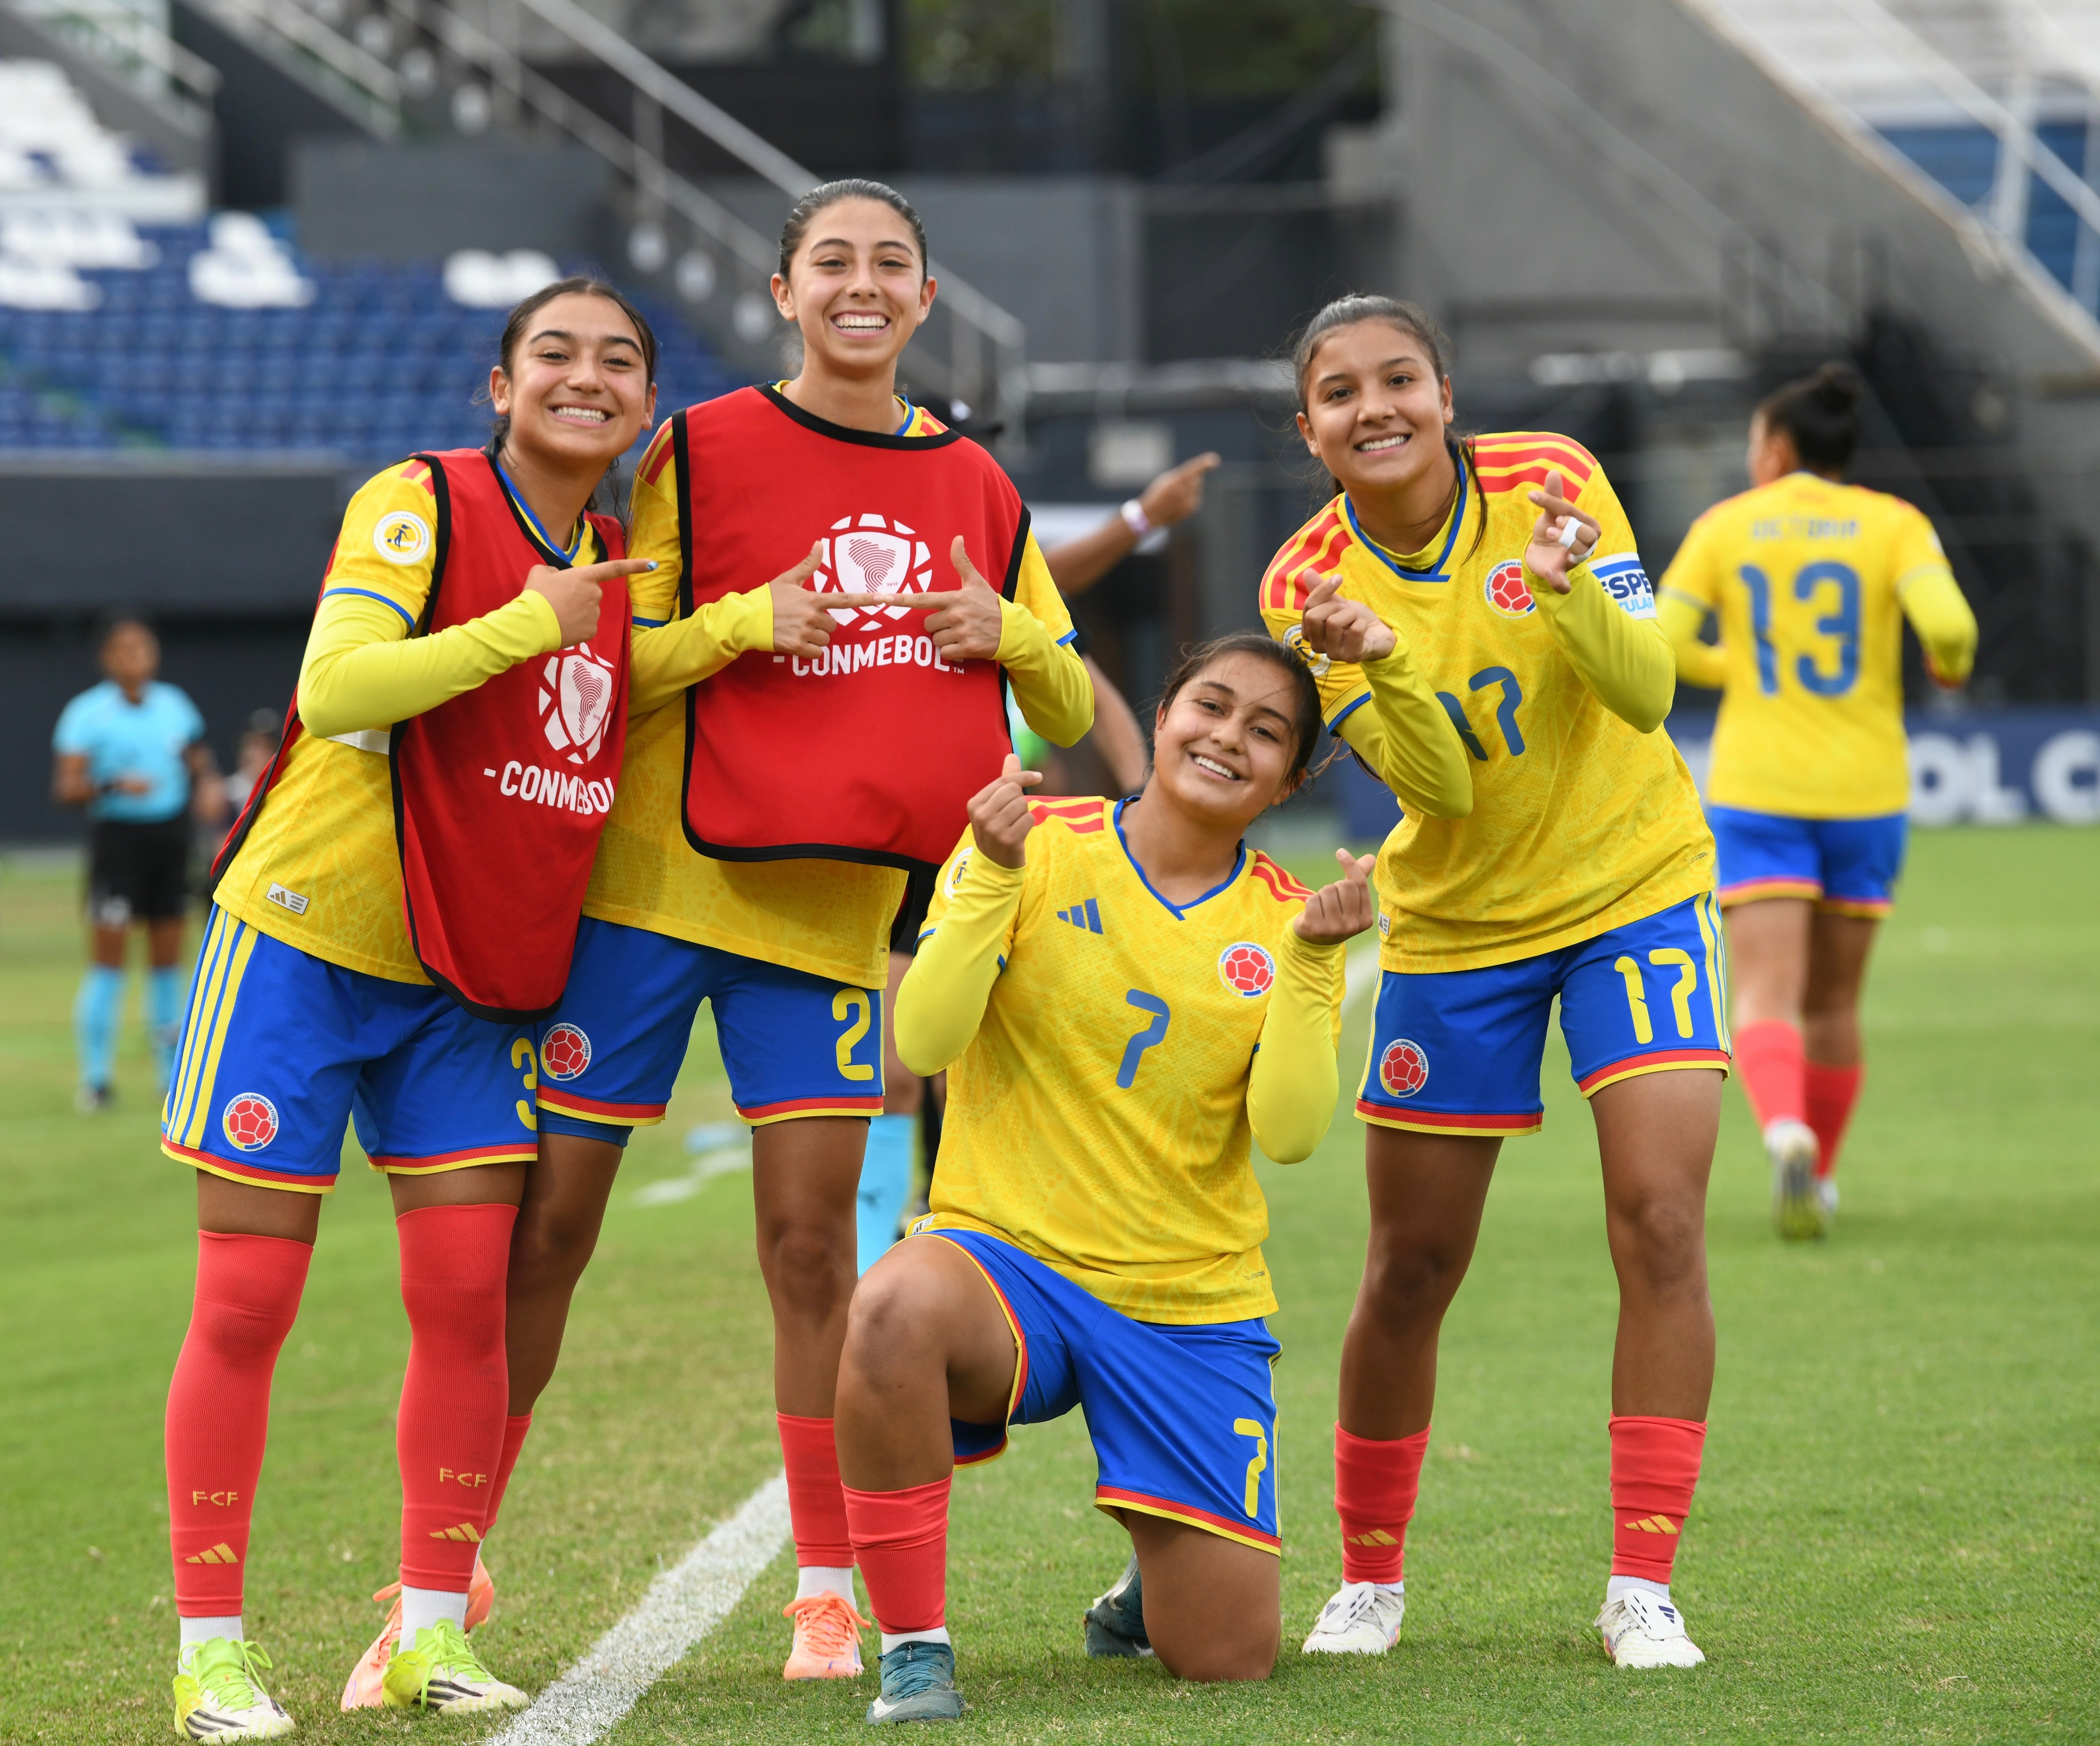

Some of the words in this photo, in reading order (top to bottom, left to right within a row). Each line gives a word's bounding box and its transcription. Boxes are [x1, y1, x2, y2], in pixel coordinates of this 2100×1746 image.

[792, 635, 950, 676] CONMEBOL
[1739, 560, 1860, 696] 13
[1435, 666, 1525, 761] 17
[559, 1025, 583, 1037] COLOMBIANA
[832, 988, 874, 1081] 2
[1116, 989, 1170, 1089] 7
[1614, 948, 1697, 1044] 17
[511, 1038, 537, 1131] 3
[1394, 1041, 1417, 1051] COLOMBIANA
[243, 1095, 268, 1106] COLOMBIANA
[193, 1491, 238, 1506] FCF
[440, 1468, 487, 1487] FCF
[1234, 1418, 1267, 1518] 7
